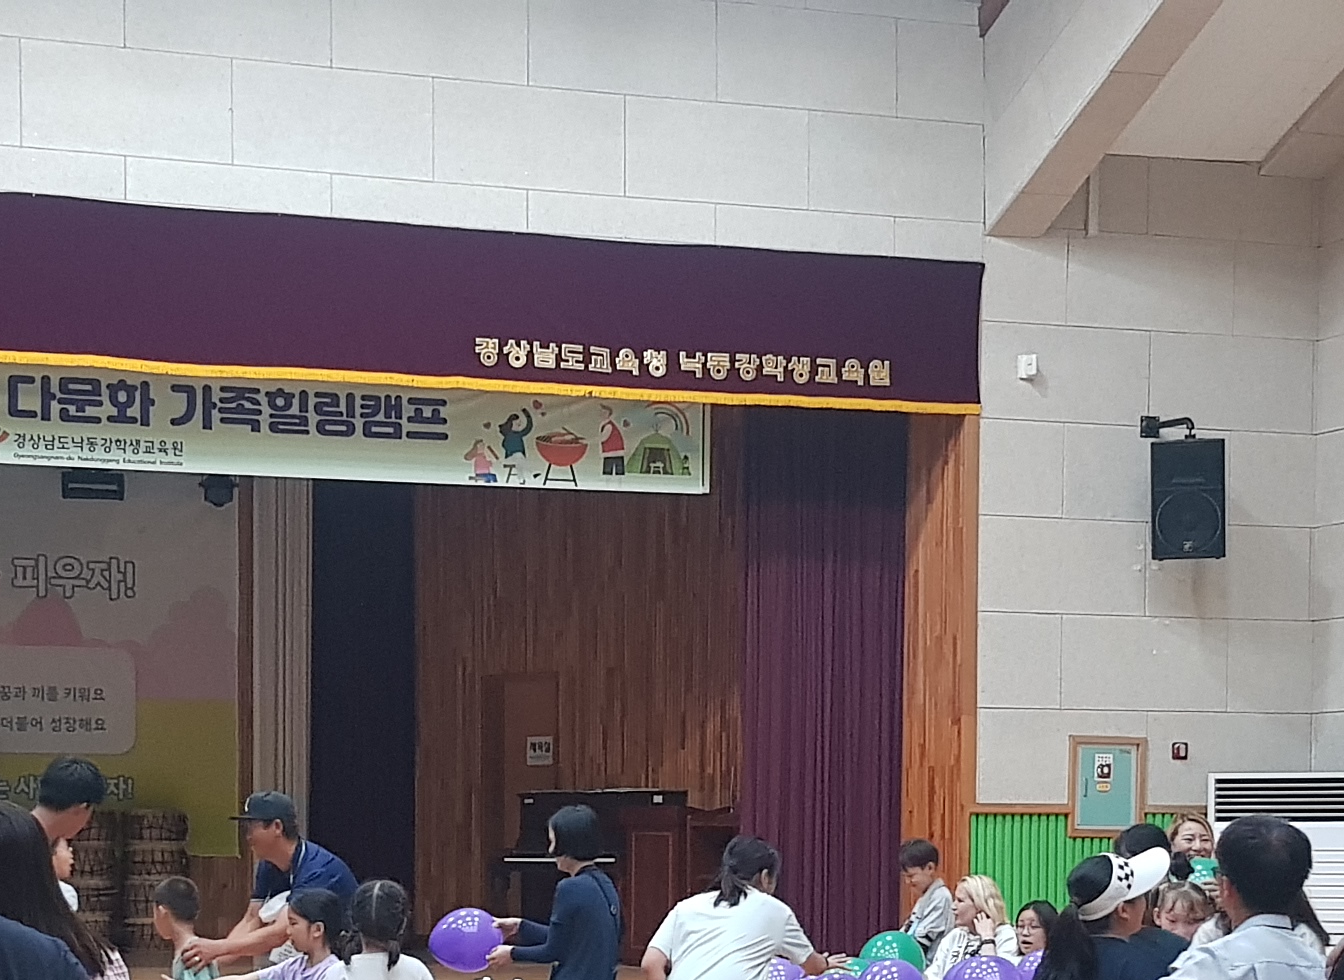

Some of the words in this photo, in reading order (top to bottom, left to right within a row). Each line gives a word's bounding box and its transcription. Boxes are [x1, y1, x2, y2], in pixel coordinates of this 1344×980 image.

[475, 337, 668, 378] 경상남도교육청
[679, 351, 891, 387] 낙동강학생교육원
[7, 375, 156, 427] 다문화
[169, 384, 449, 440] 가족힐링캠프
[13, 433, 184, 457] 경상남도낙동강학생교육원
[11, 553, 136, 601] 피우자!
[63, 686, 106, 702] 키워요
[0, 715, 44, 732] 더불어
[50, 716, 108, 733] 성장해요
